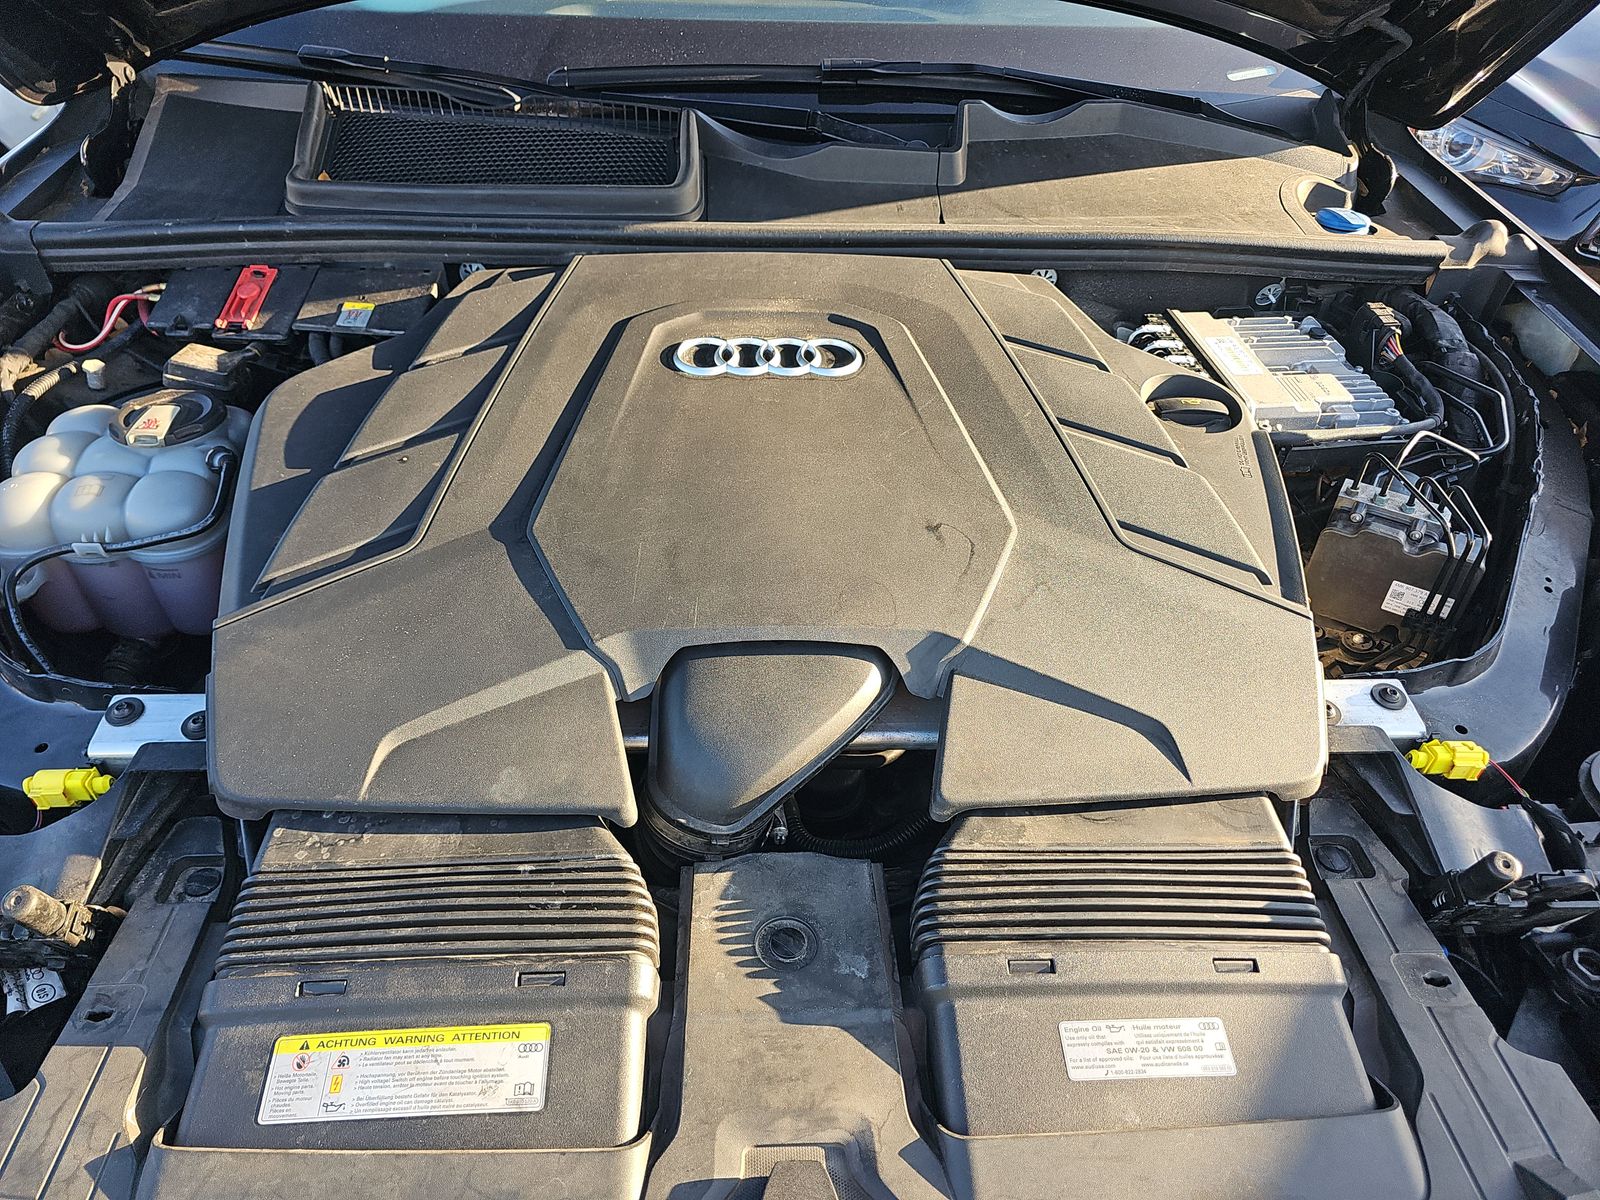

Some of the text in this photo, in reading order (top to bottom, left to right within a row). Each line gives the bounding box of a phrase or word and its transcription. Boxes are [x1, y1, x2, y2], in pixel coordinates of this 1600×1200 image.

[316, 1031, 521, 1048] ACHTUNG WARNING ATTENTION
